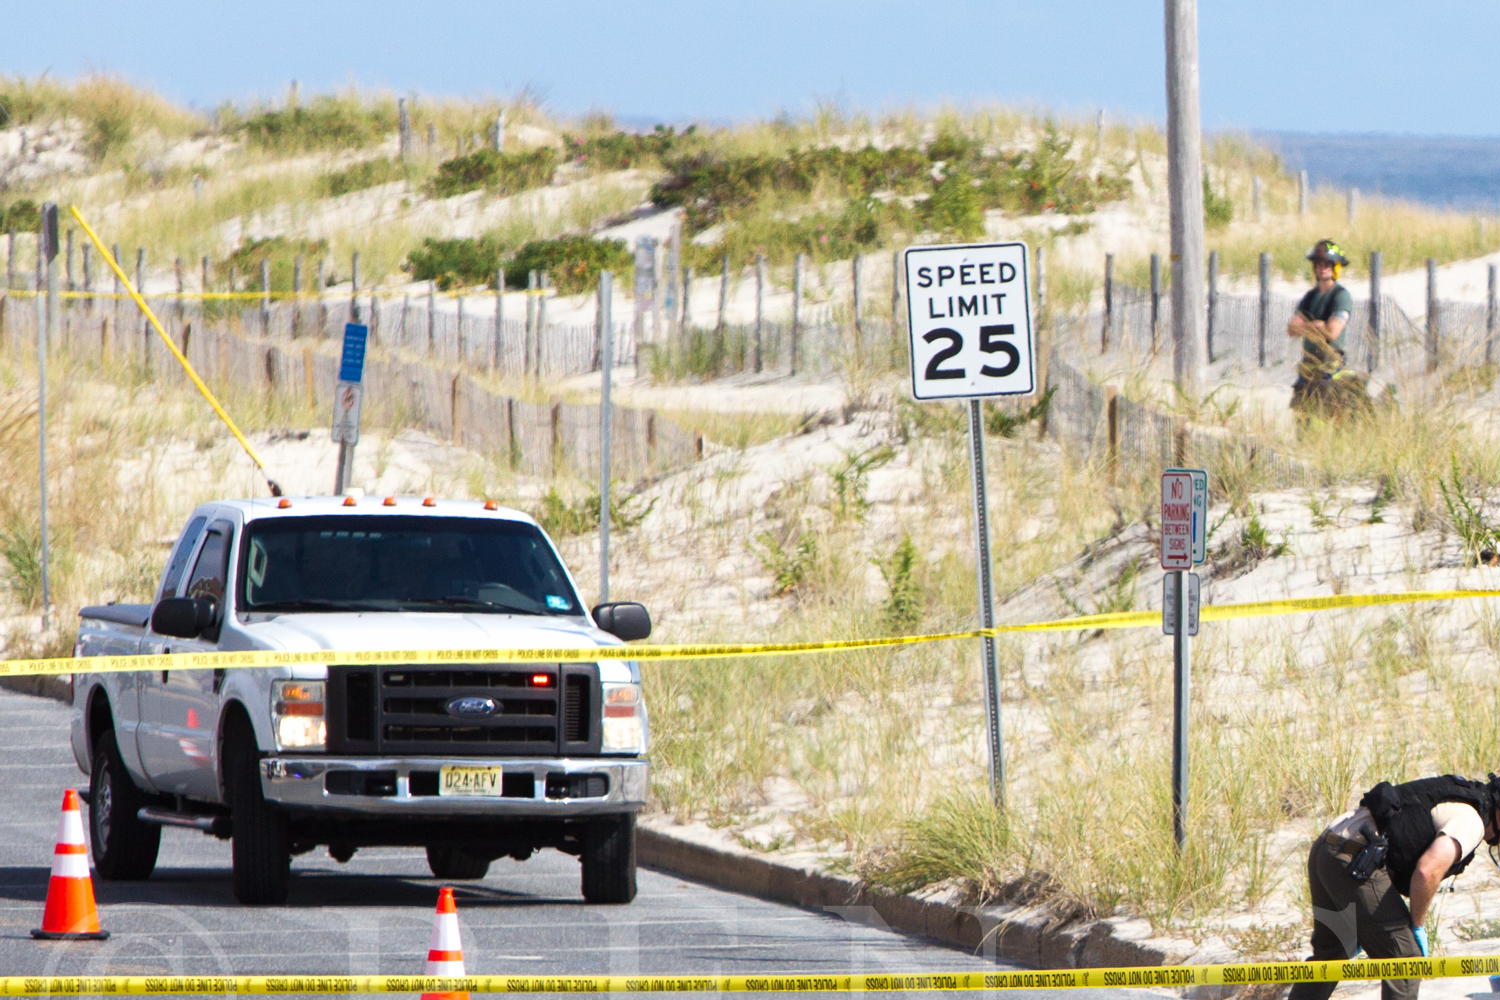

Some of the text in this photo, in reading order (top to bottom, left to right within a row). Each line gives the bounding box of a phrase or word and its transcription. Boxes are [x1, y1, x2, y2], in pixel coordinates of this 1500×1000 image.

[917, 262, 1016, 288] SPEED
[928, 293, 1006, 319] LIMIT
[922, 324, 1020, 380] 25
[1172, 481, 1183, 499] NO
[1164, 503, 1189, 521] PARKING
[1165, 523, 1189, 535] BETWEEN
[1169, 538, 1185, 550] SIGNS
[518, 648, 579, 659] POLICE LINE DO NOT CROSS
[1273, 965, 1287, 980] LINE
[1290, 964, 1313, 979] POLICE
[1342, 961, 1432, 977] POLICE LINE DO NOT CROSS
[1461, 958, 1483, 973] CROSS
[1485, 958, 1498, 972] NOT
[984, 973, 1075, 988] POLICE LINE DO NOT CROSS
[1104, 969, 1194, 985] POLICE LINE DO NOT CROSS
[1223, 967, 1245, 982] CROSS
[1247, 966, 1260, 981] NOT
[1262, 966, 1271, 980] DO
[265, 978, 356, 991] POLICE LINE DO NOT CROSS
[506, 979, 596, 991] POLICE LINE DO NOT CROSS
[865, 976, 956, 989] POLICE LINE DO NOT CROSS
